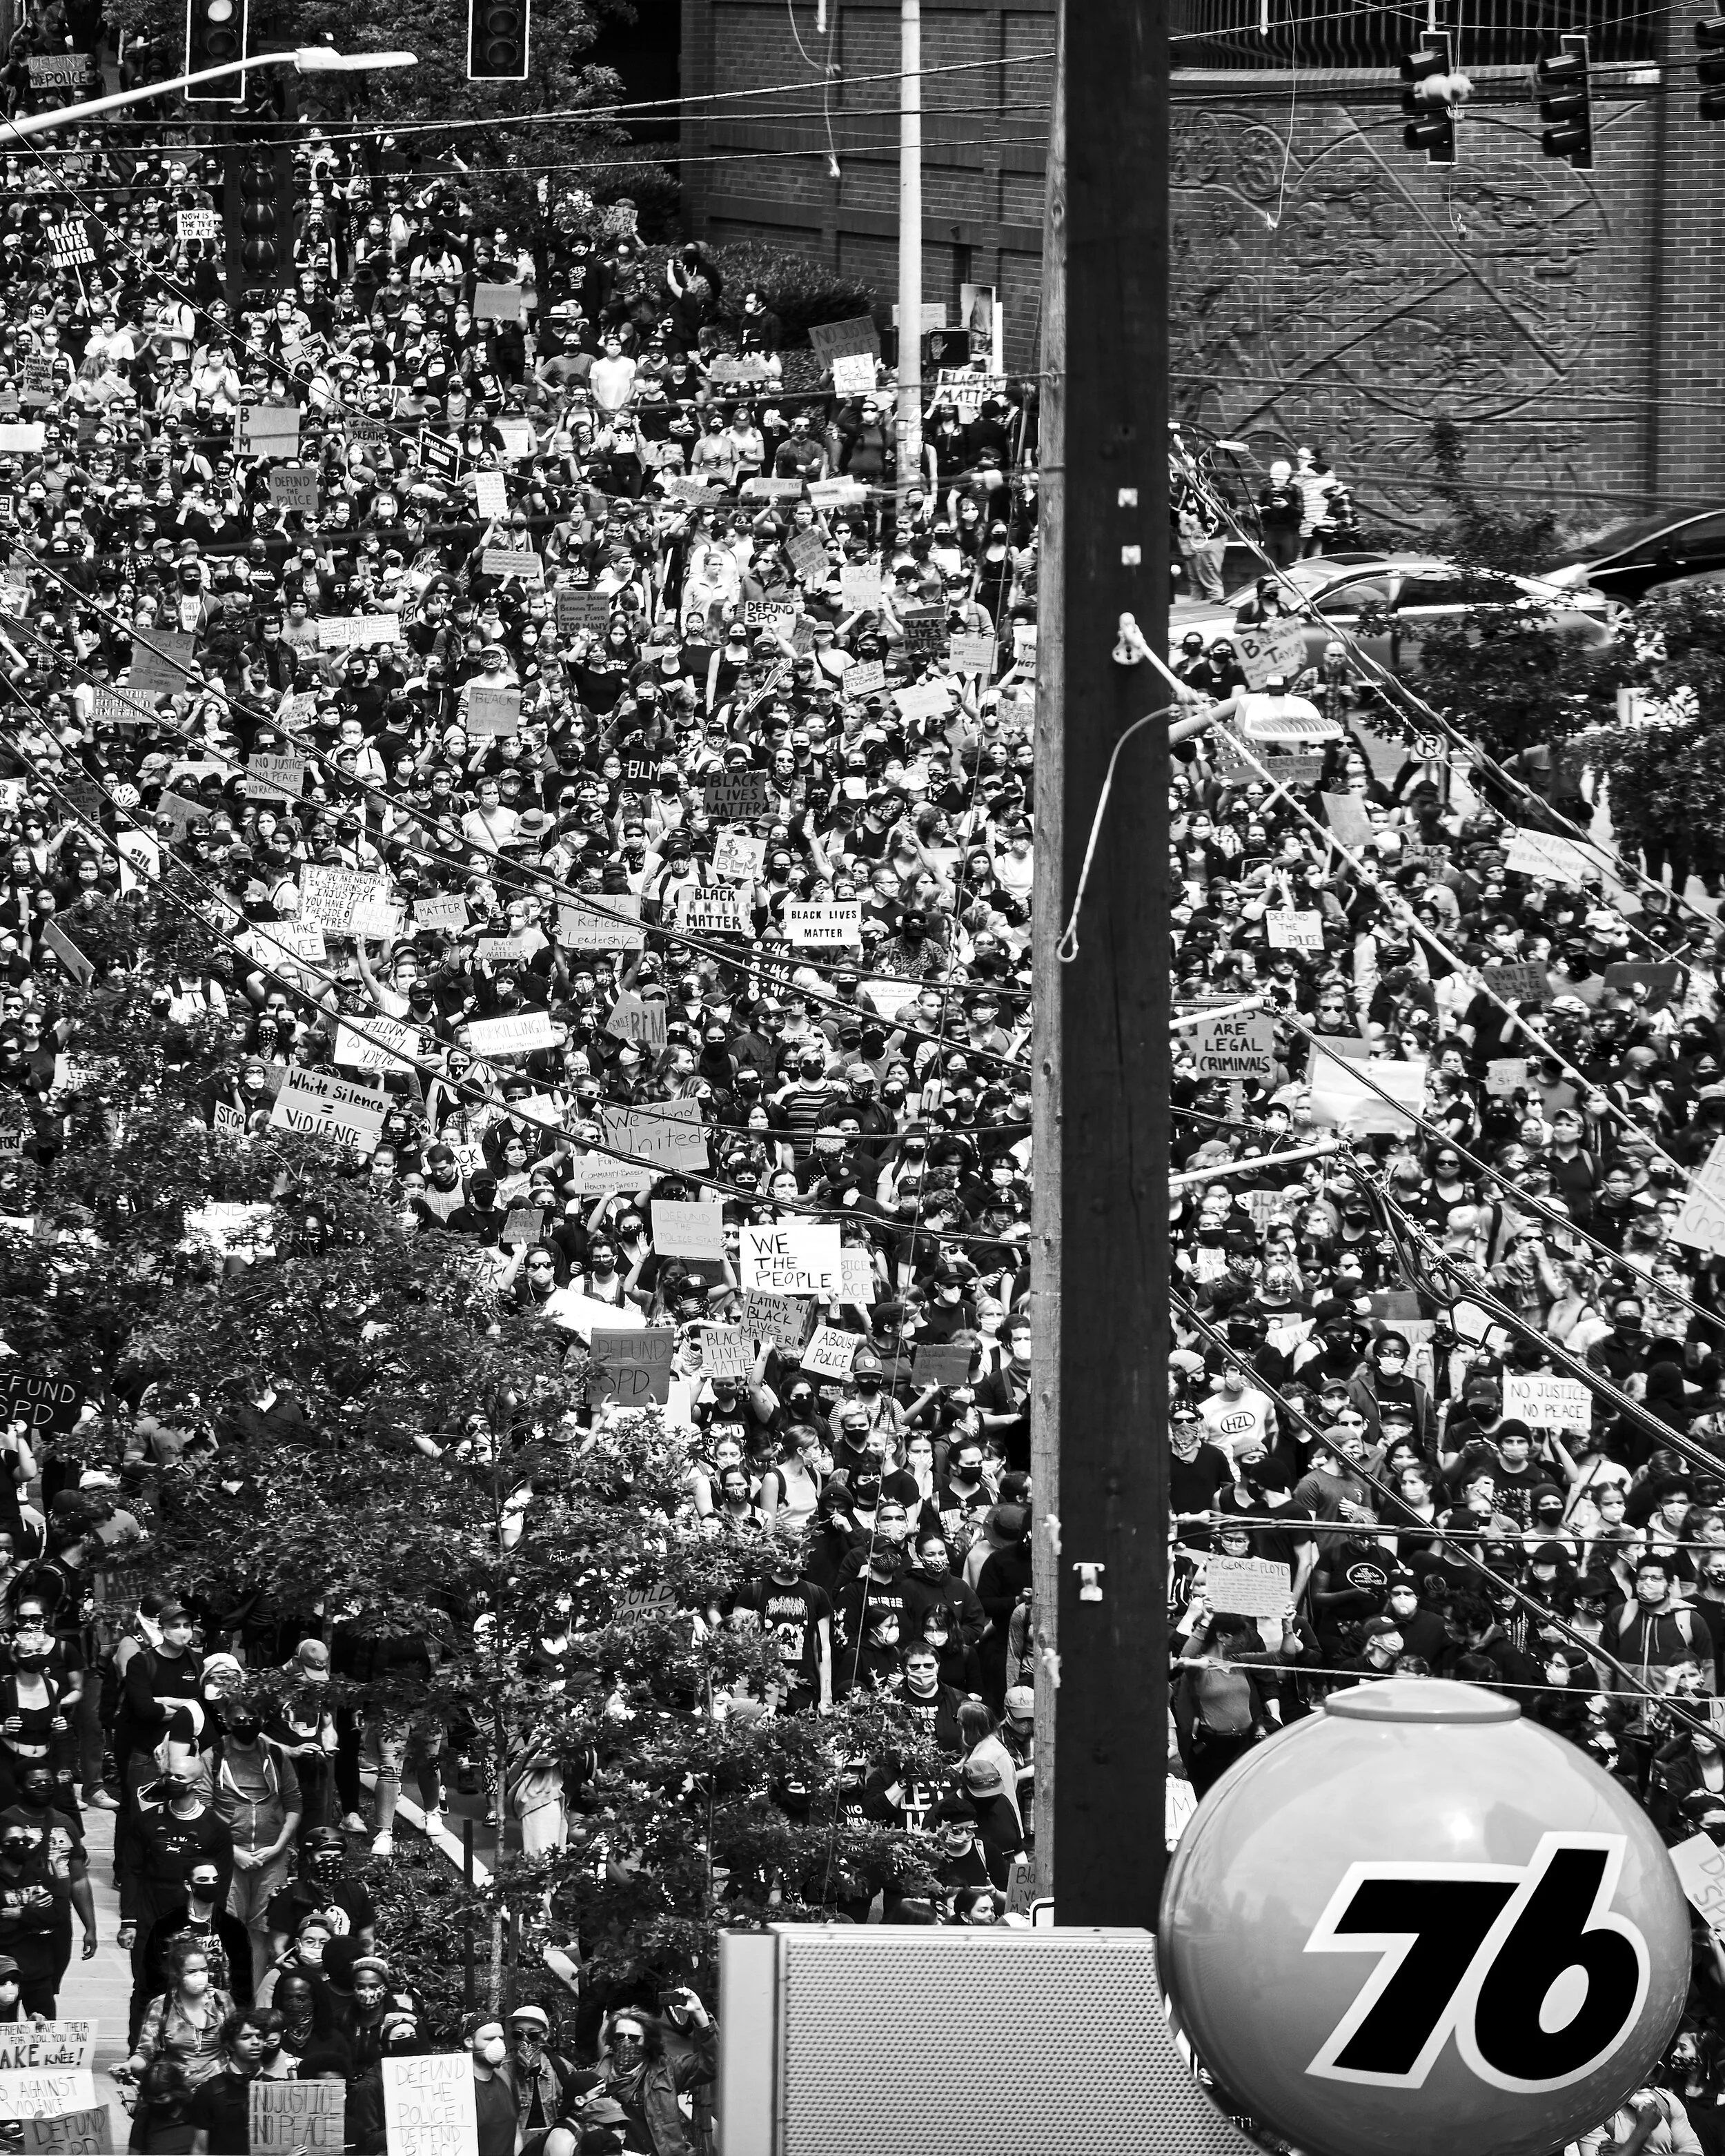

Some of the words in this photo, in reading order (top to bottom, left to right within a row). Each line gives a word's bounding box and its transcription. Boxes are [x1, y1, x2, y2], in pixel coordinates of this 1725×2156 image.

[30, 56, 85, 71] DEFUND
[46, 71, 87, 84] POLICE
[48, 220, 86, 241] BLACK
[55, 233, 89, 253] LIVES
[52, 248, 97, 268] MATTER
[353, 431, 387, 442] BREATHE
[425, 437, 442, 447] BLACK
[276, 476, 310, 487] DEFUND
[277, 495, 312, 506] POLICE
[845, 568, 882, 583] BLACK
[747, 602, 795, 615] DEFUND
[747, 613, 778, 624] SPD
[562, 623, 580, 632] TOO
[582, 622, 608, 631] MANY
[907, 629, 942, 639] LIVES
[844, 667, 863, 678] BLACK
[475, 693, 515, 706] BLACK
[255, 759, 268, 769] NO
[271, 758, 303, 771] JUSTICE
[628, 760, 661, 782] BLM
[270, 773, 299, 783] PEACE
[710, 774, 759, 787] BLACK
[715, 788, 758, 801] LIVES
[706, 802, 762, 815] MATTER
[716, 857, 759, 878] BLM
[308, 870, 321, 879] IF
[324, 873, 338, 882] YOU
[338, 874, 353, 883] ARE
[353, 876, 385, 887] NEUTRAL
[308, 879, 320, 887] IN
[364, 884, 377, 894] OF
[308, 896, 325, 907] YOU
[328, 898, 348, 909] HAVE
[417, 898, 437, 909] BLACK
[442, 896, 462, 906] LIVES
[694, 889, 735, 902] BLACK
[306, 905, 322, 916] THE
[322, 907, 342, 918] SIDE
[355, 904, 395, 922] SILENCE
[420, 904, 461, 918] MATTER
[682, 901, 718, 916] TRANS
[791, 911, 822, 920] BLACK
[829, 910, 857, 919] LIVES
[687, 914, 742, 930] MATTER
[1270, 912, 1308, 921] DEFUND
[288, 922, 318, 935] TAKE
[351, 920, 393, 935] VIOLENCE
[804, 929, 843, 938] MATTER
[1279, 923, 1297, 931] THE
[567, 931, 638, 949] Leadership
[256, 942, 268, 958] A
[276, 938, 322, 958] KNEE
[1491, 966, 1539, 980] WHITE
[363, 1020, 408, 1037] MATTER
[495, 1020, 535, 1040] KILLING
[1213, 1022, 1248, 1036] ARE
[1205, 1038, 1263, 1051] LEGAL
[362, 1050, 395, 1067] BLACK
[1200, 1056, 1271, 1074] CRIMINALS
[288, 1069, 328, 1096] White
[333, 1085, 384, 1113] Silence
[217, 1105, 244, 1129] STOP
[607, 1109, 640, 1130] We
[615, 1127, 702, 1154] United
[584, 1181, 607, 1190] HEALTH
[614, 1180, 639, 1189] SAFETY
[509, 1211, 535, 1223] BLACK
[659, 1209, 711, 1222] DEFUND
[659, 1233, 693, 1244] POLICE
[749, 1232, 789, 1255] WE
[754, 1256, 798, 1269] THE
[841, 1260, 868, 1271] STICE
[756, 1271, 832, 1289] PEOPLE
[750, 1293, 788, 1312] LATINX
[796, 1303, 803, 1314] 4
[747, 1305, 792, 1325] BLACK
[749, 1319, 781, 1334] LIVES
[706, 1332, 751, 1347] BLACK
[818, 1330, 857, 1350] ABOLISH
[598, 1339, 667, 1361] DEFUND
[711, 1346, 750, 1361] LIVES
[813, 1348, 848, 1368] POLICE
[599, 1368, 649, 1394] SPD
[1510, 1382, 1530, 1398] NO
[1537, 1382, 1588, 1401] JUSTICE
[1524, 1403, 1538, 1418] NO
[1545, 1403, 1584, 1418] PEACE
[1221, 1559, 1257, 1572] GEORGE
[1260, 1562, 1289, 1576] FLOYD
[1016, 1866, 1036, 1885] Bla
[1011, 1889, 1036, 1903] Live
[1311, 1837, 1647, 2089] 76
[0, 2024, 31, 2035] FRIENDS
[63, 2021, 90, 2033] THEIR
[10, 2036, 26, 2046] FOR
[69, 2033, 88, 2043] CAN
[0, 2044, 40, 2069] AKE
[44, 2046, 84, 2066] KNEE!
[395, 2058, 466, 2086] DEFUND
[20, 2076, 77, 2099] AGAINST
[410, 2084, 452, 2101] THE
[254, 2084, 273, 2114] NO
[274, 2084, 343, 2115] JUSTICE
[397, 2102, 466, 2126] POLICE!
[32, 2108, 106, 2146] DEFUND
[253, 2115, 276, 2146] NO
[280, 2116, 342, 2147] PEACE
[400, 2127, 461, 2148] DEFEND
